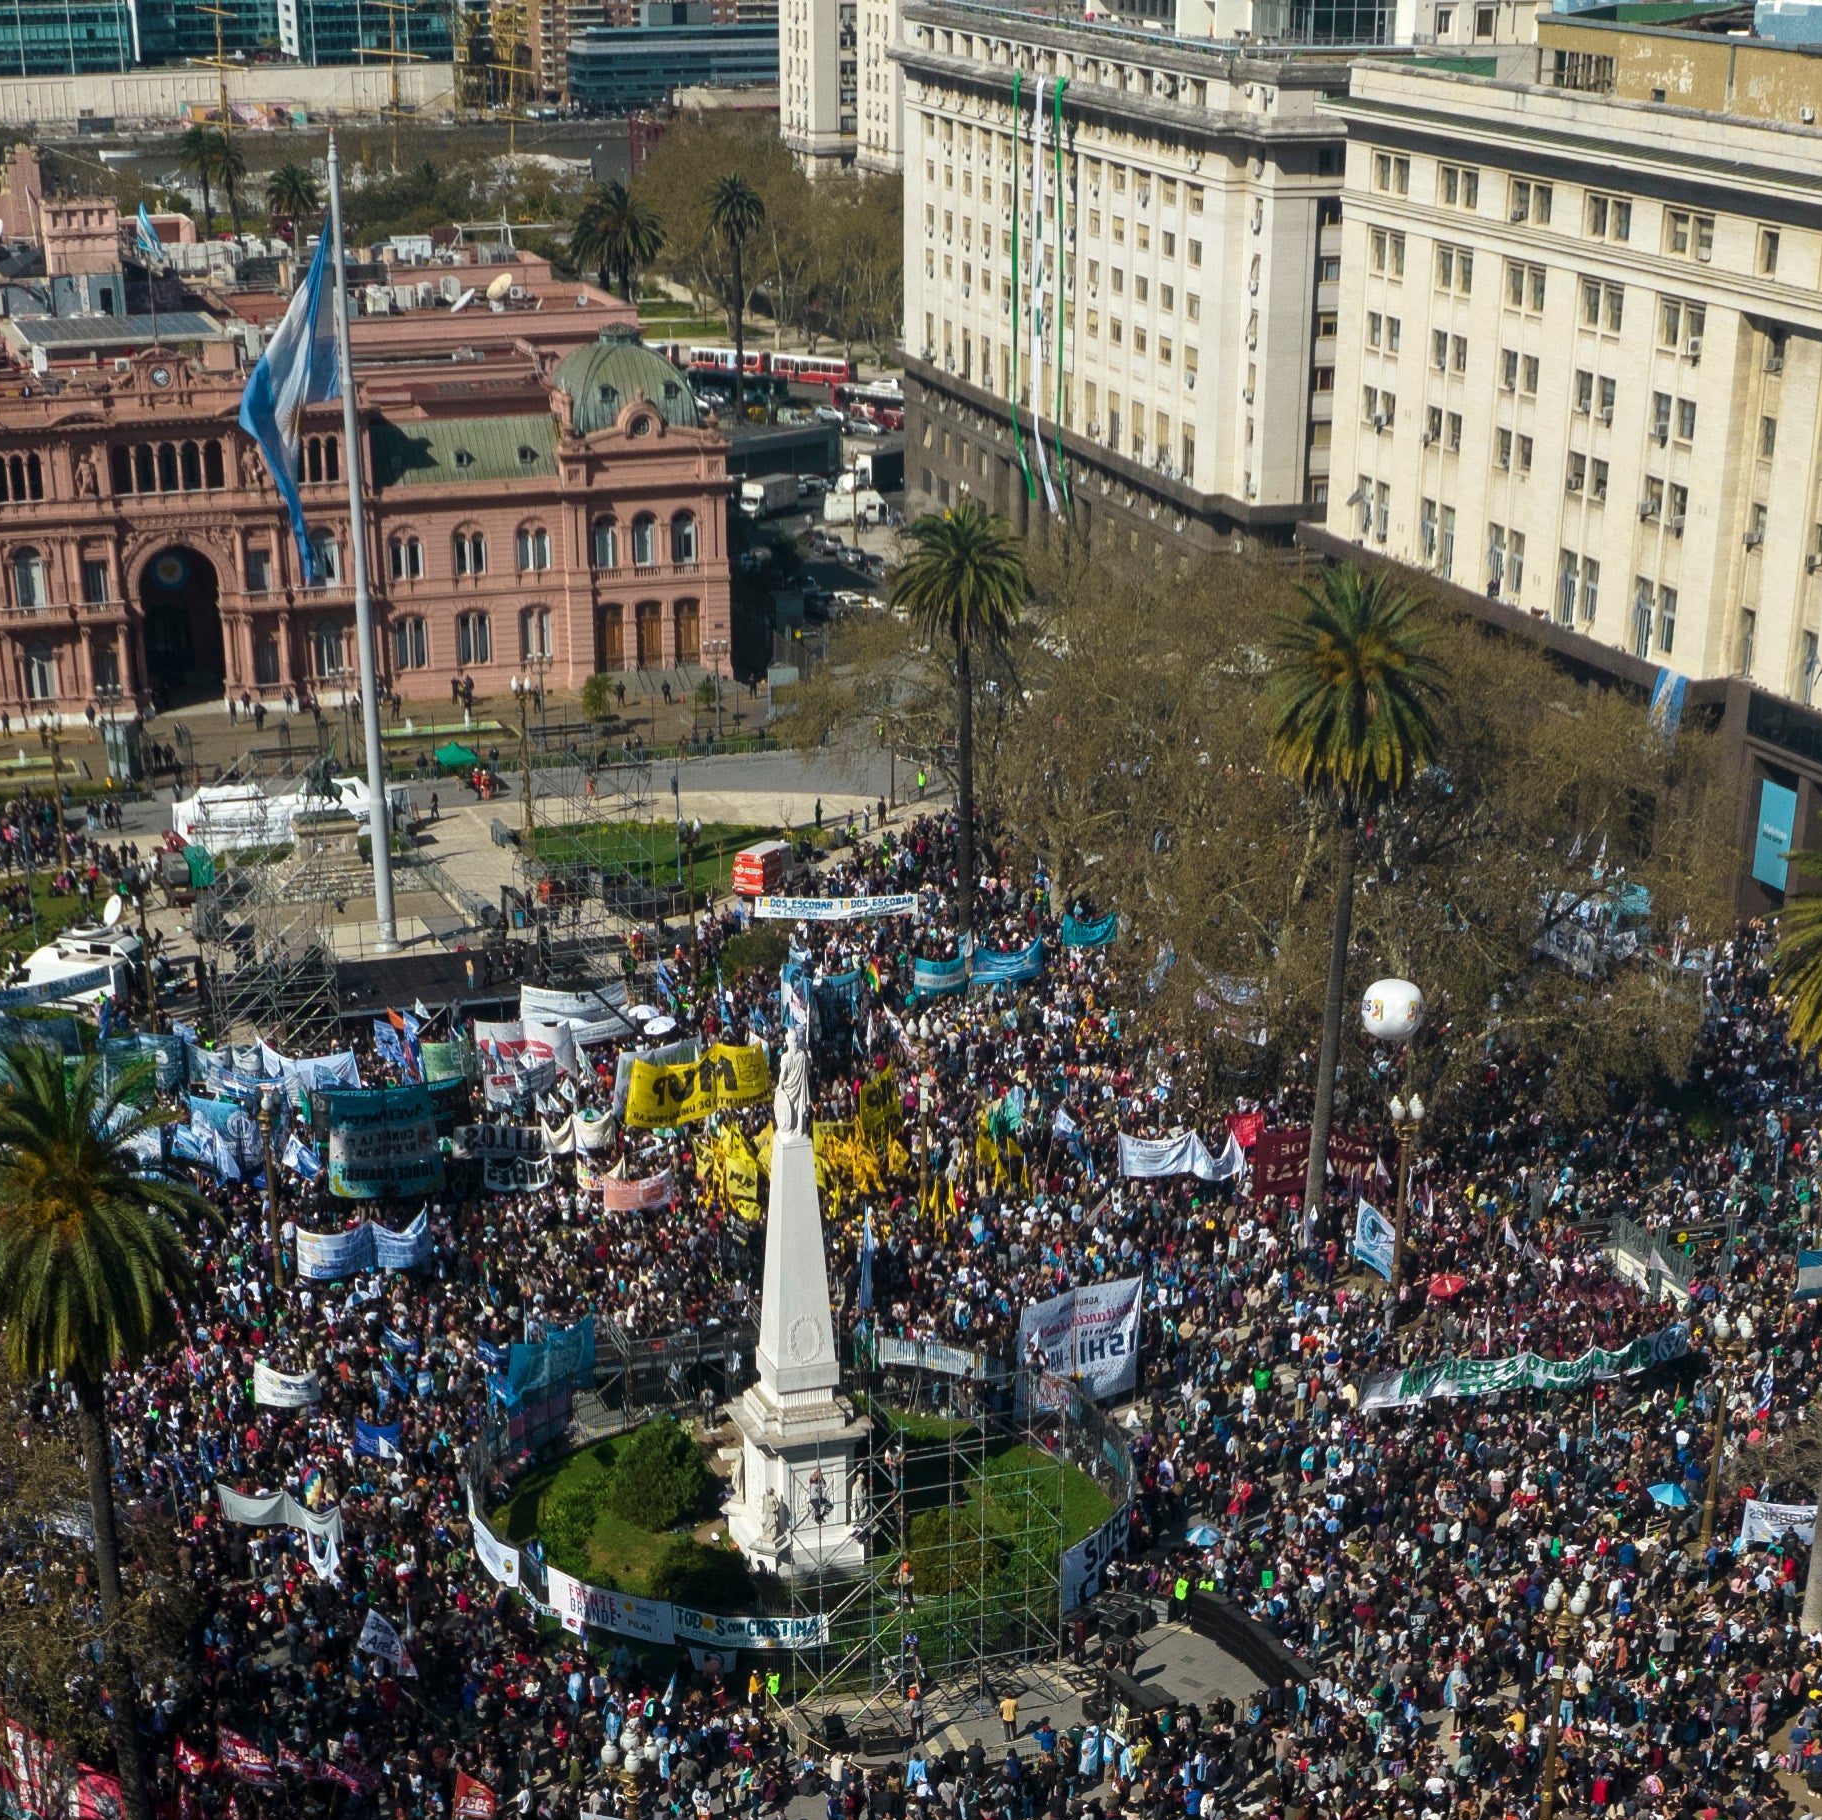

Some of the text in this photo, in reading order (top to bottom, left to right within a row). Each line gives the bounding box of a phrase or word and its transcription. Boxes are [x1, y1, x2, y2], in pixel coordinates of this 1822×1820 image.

[792, 899, 833, 911] ESCOBAR
[872, 896, 914, 908] ESCOBAR
[568, 1583, 616, 1614] FRENTE
[569, 1601, 617, 1627] GRANDE
[627, 1618, 652, 1633] PILAR
[746, 1617, 819, 1638] CRISTINA
